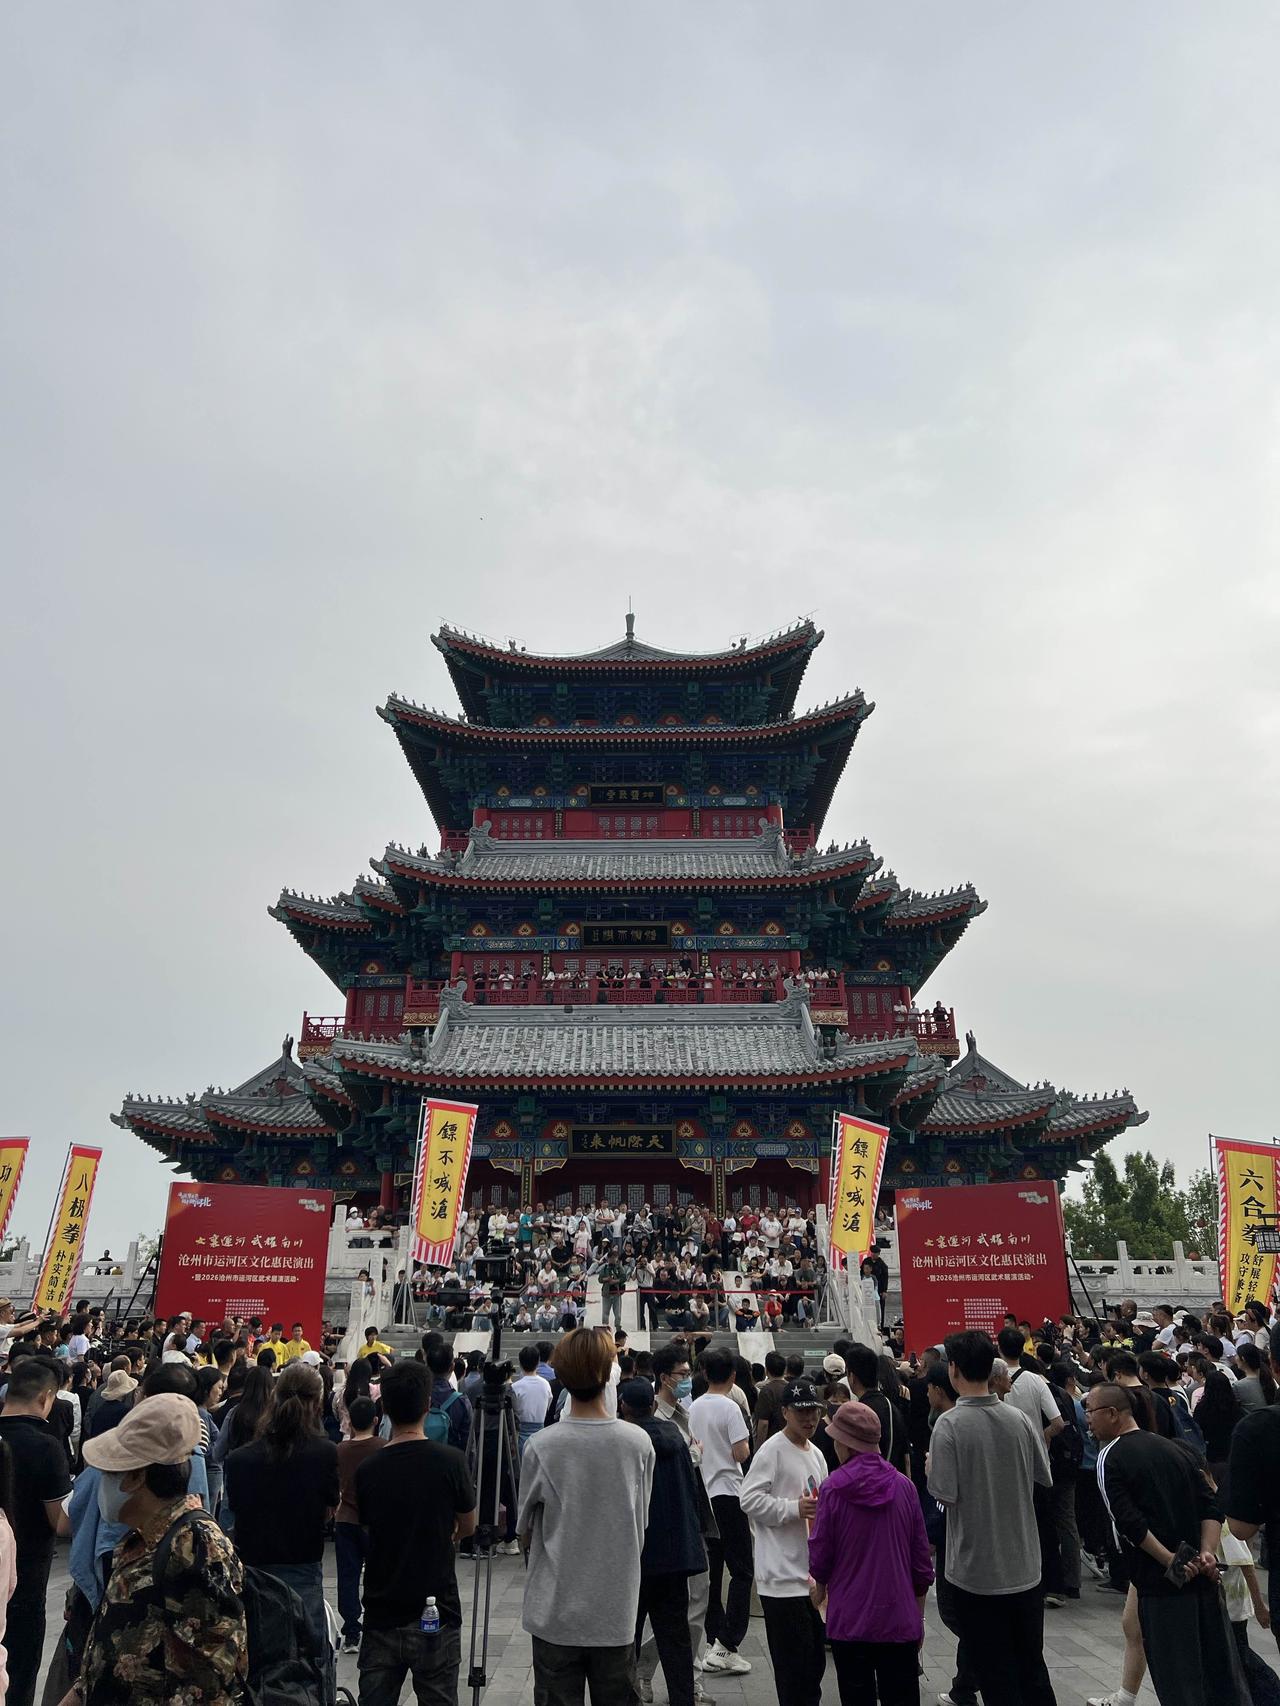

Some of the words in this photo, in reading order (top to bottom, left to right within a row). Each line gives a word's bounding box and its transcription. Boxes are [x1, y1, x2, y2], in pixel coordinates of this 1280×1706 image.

[61, 1172, 89, 1245] 八极拳
[1239, 1168, 1267, 1247] 六合拳
[178, 1253, 314, 1269] 沧州市运河区文化惠民演出
[912, 1252, 1048, 1268] 沧州市运河区文化惠民演出
